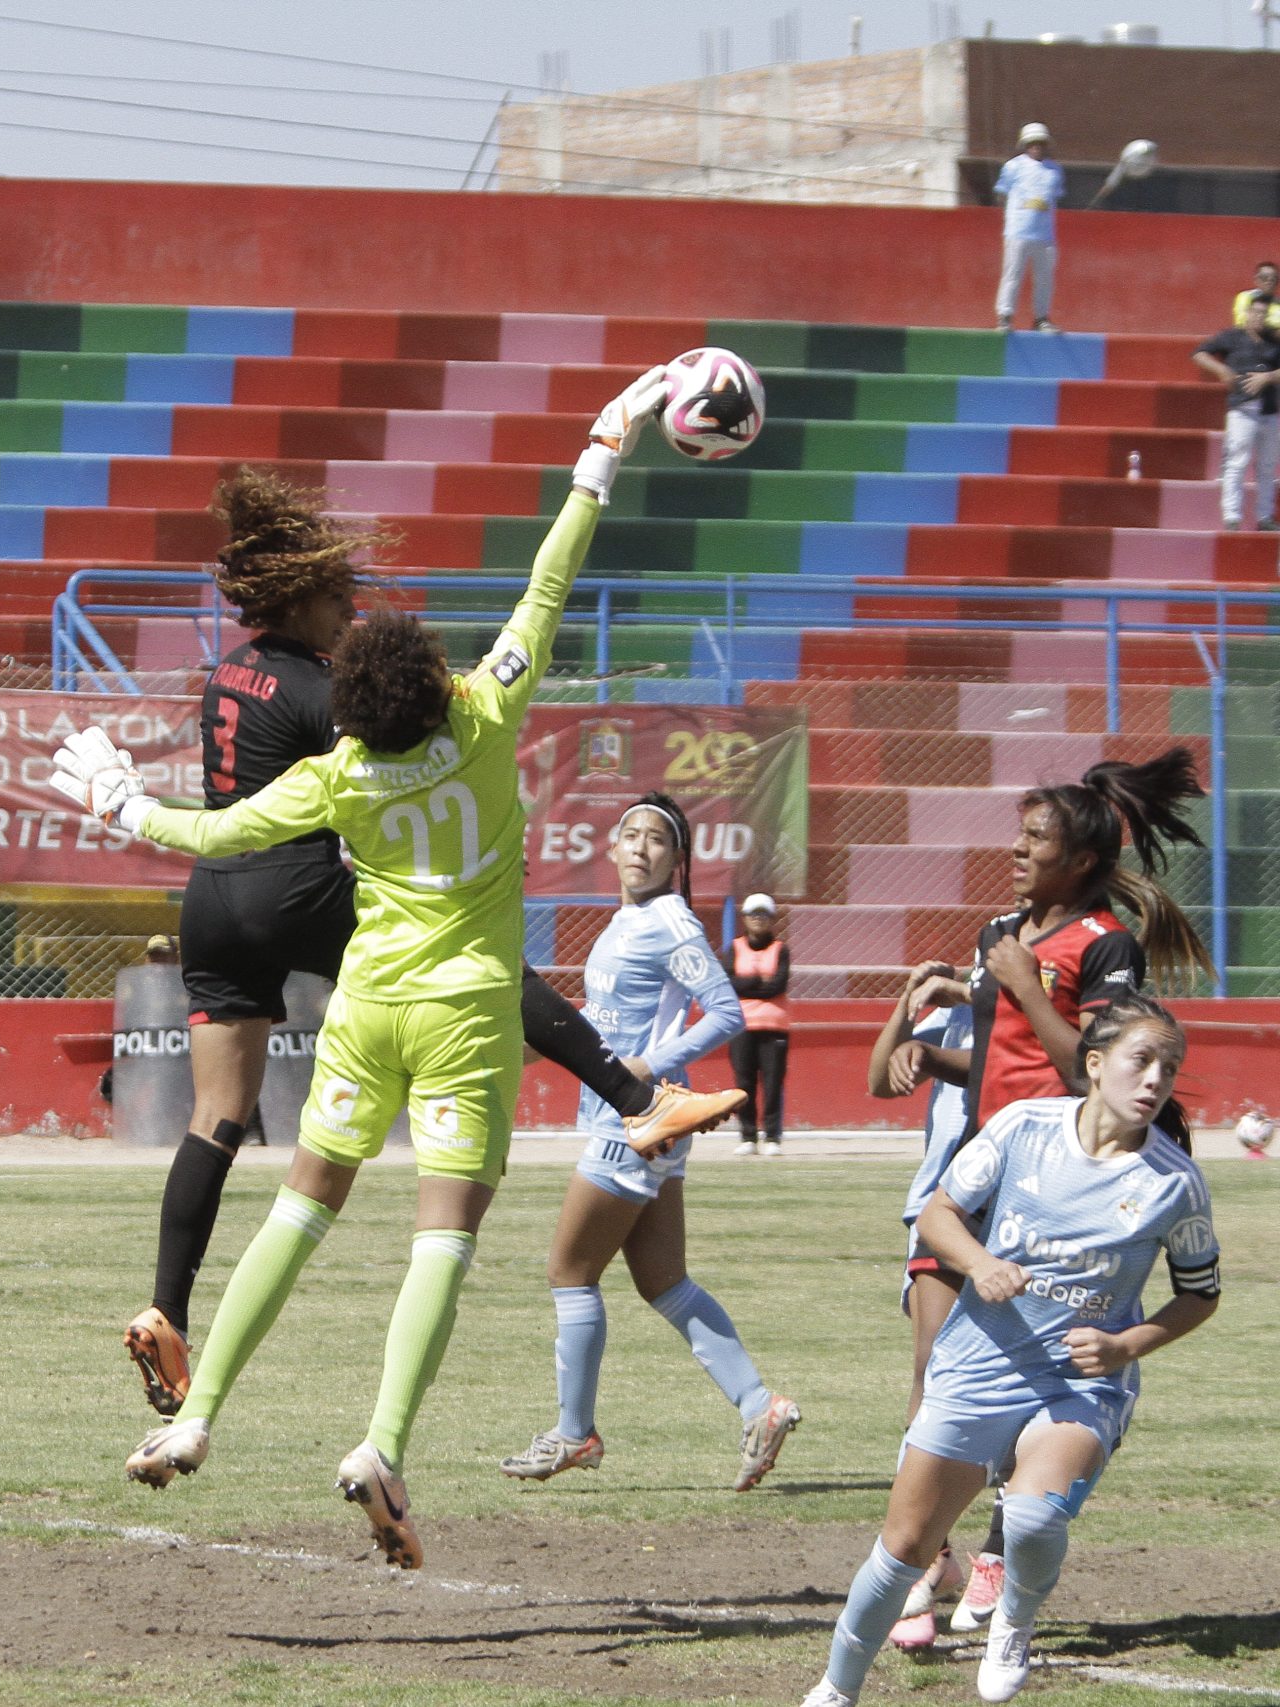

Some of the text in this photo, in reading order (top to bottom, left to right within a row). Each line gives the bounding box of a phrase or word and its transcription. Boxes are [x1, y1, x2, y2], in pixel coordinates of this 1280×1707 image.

[19, 708, 77, 742] LA
[89, 713, 197, 746] TOM
[210, 697, 239, 793] 3
[138, 763, 204, 794] PIS
[381, 780, 499, 890] 22
[540, 822, 596, 864] ES
[113, 1030, 191, 1057] POLICI
[1171, 1218, 1210, 1255] MG
